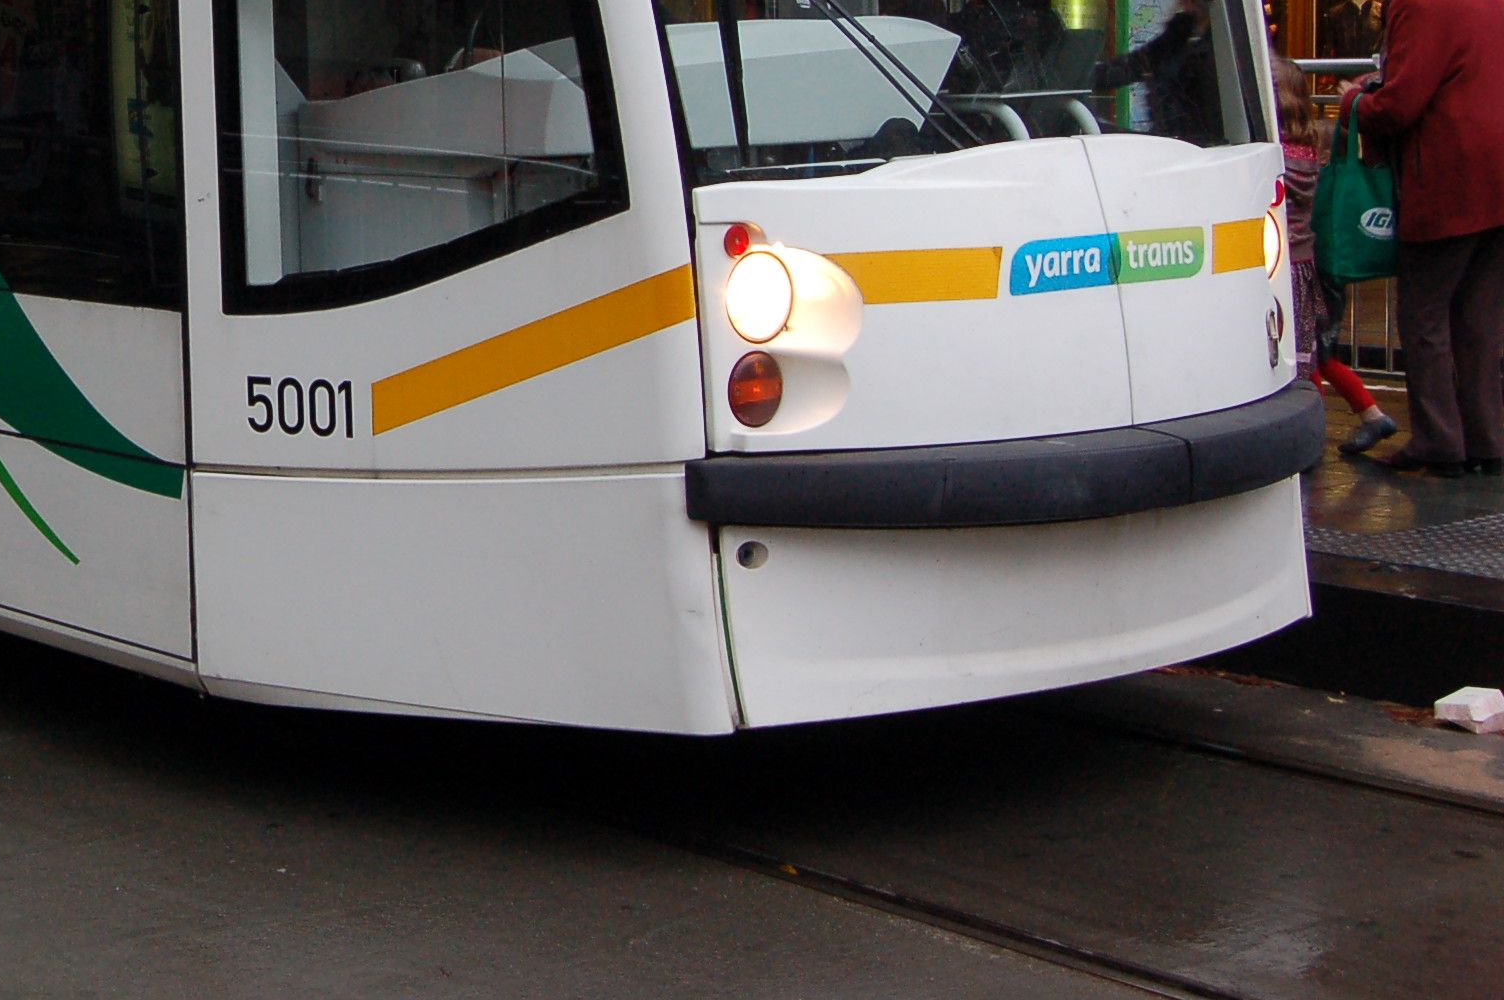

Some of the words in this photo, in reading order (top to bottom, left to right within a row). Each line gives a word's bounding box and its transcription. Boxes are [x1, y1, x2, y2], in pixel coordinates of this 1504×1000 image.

[1025, 246, 1101, 287] yarra
[1126, 239, 1195, 269] trams
[247, 376, 353, 438] 5001
